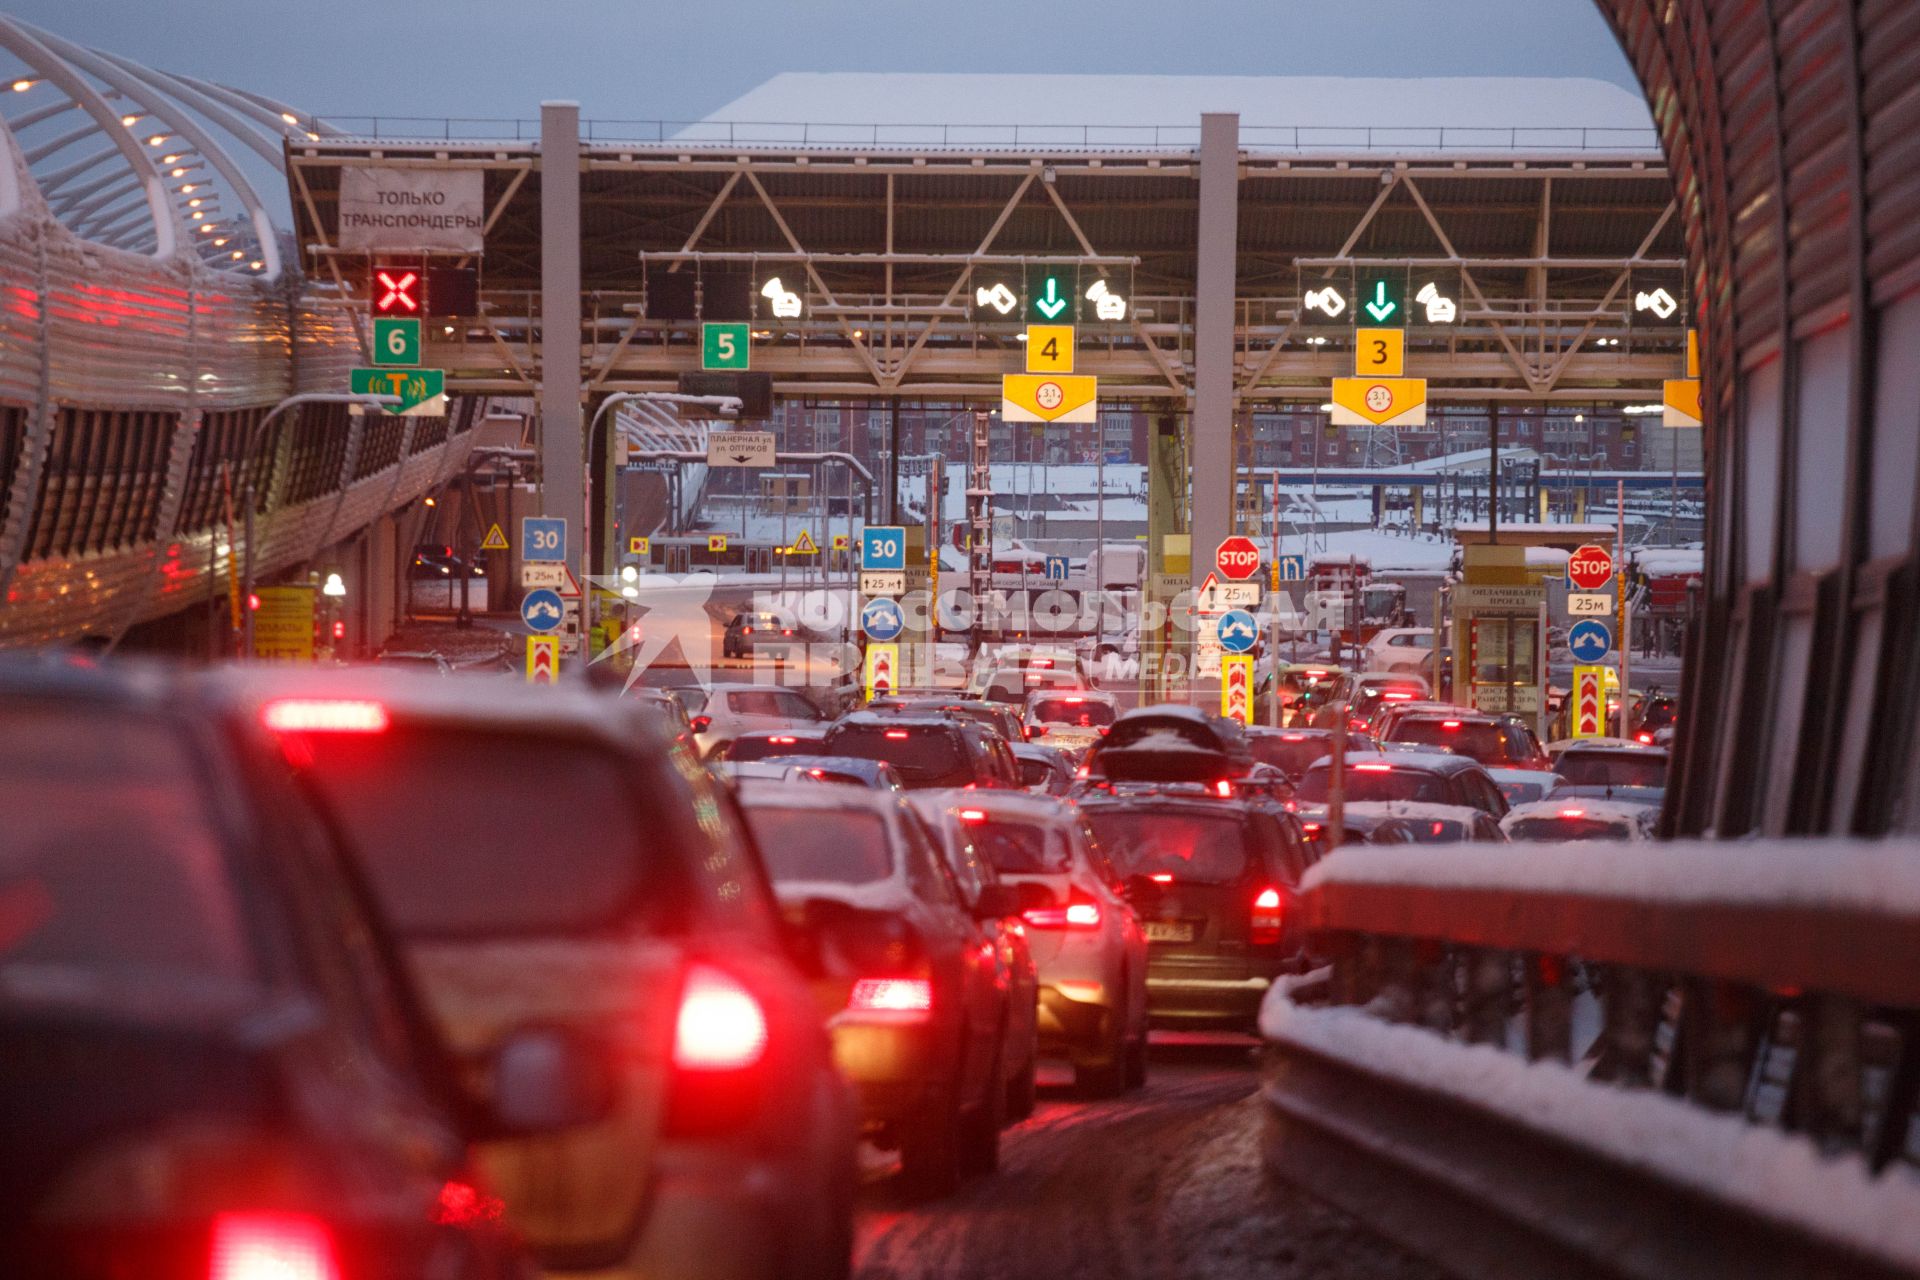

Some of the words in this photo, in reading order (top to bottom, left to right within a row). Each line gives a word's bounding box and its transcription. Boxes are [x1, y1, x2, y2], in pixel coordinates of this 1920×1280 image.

[378, 191, 445, 206] ТОЛЬКО
[343, 213, 481, 230] ТРАНСПОНДЕРЫ
[388, 328, 406, 355] 6
[718, 333, 735, 360] 5
[1041, 337, 1059, 361] 4
[1372, 340, 1388, 364] 3
[710, 435, 760, 443] ПЛАНЕРНАЯ
[533, 530, 558, 549] 30
[871, 540, 896, 558] 30
[1219, 551, 1258, 566] STOP
[1572, 561, 1610, 575] STOP
[872, 580, 884, 588] 25
